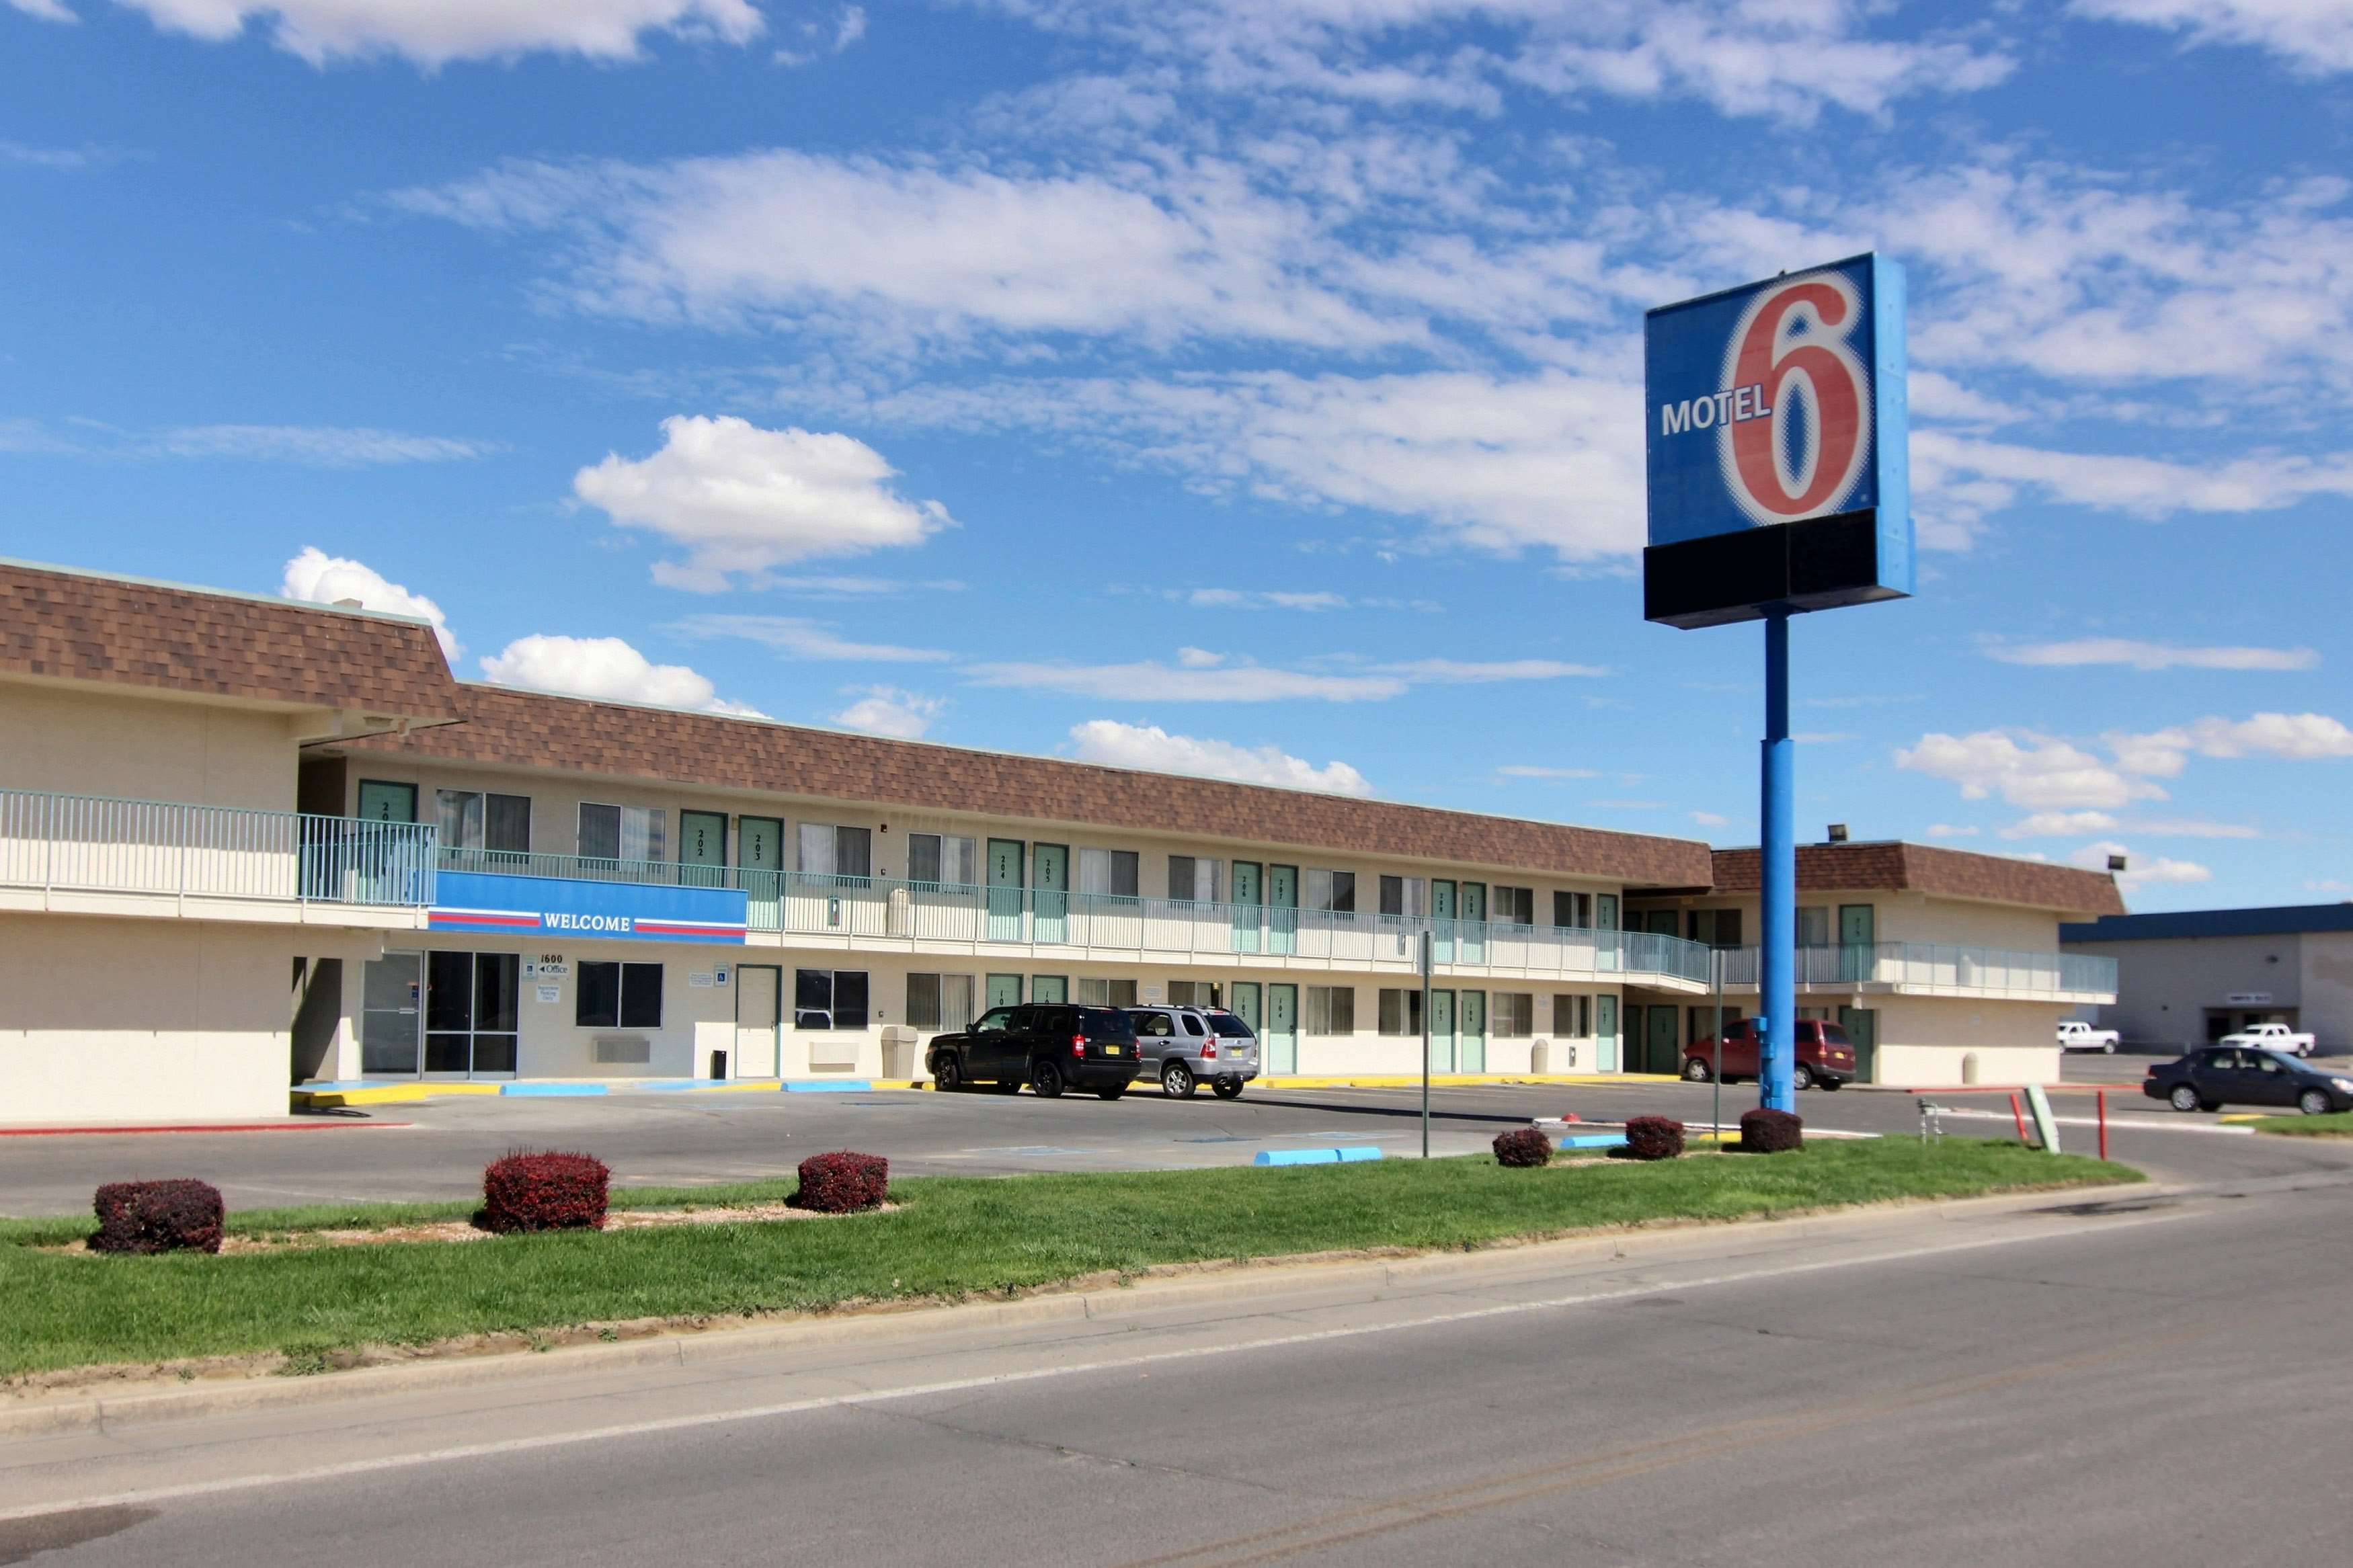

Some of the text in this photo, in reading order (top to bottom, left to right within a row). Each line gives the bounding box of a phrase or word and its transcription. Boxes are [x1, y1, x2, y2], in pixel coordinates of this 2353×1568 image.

[1662, 282, 1860, 515] MOTEL 6
[545, 913, 630, 932] WELCOME
[541, 954, 563, 964] 1600
[546, 964, 568, 973] Office
